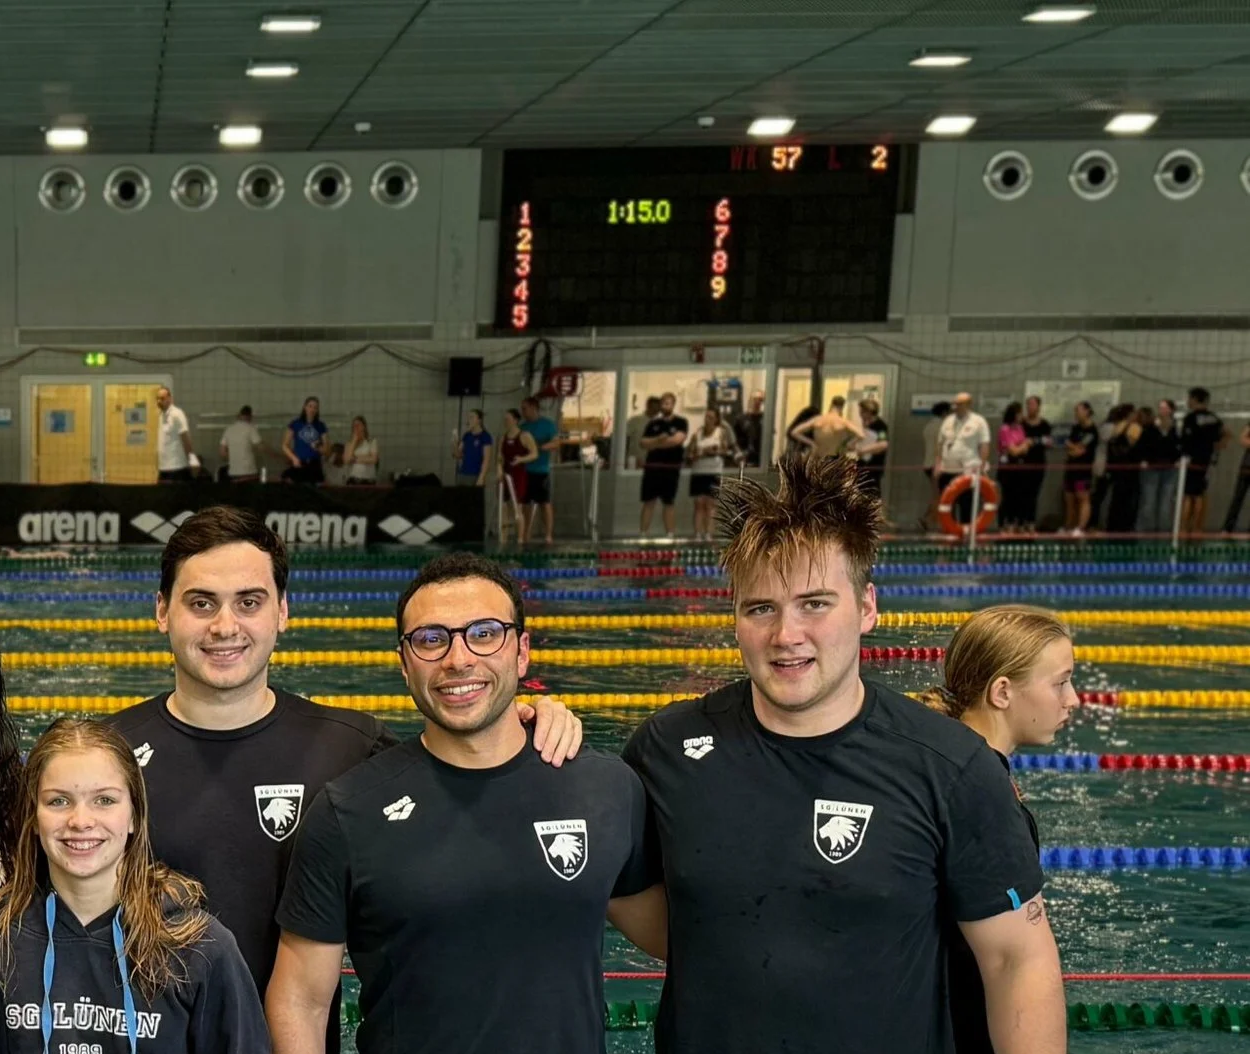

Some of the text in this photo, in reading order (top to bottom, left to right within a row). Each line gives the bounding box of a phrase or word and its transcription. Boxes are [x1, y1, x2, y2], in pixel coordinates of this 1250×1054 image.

[771, 145, 803, 170] 57
[828, 146, 842, 170] L
[870, 145, 888, 170] 2
[519, 199, 731, 225] 1 1:15.0 6
[516, 224, 729, 251] 2 7
[515, 250, 728, 277] 3 8
[514, 275, 726, 302] 4 9
[512, 304, 528, 328] 5
[19, 510, 120, 542] arena
[264, 511, 367, 545] arena
[683, 736, 713, 749] arena
[6, 996, 162, 1038] SG LÜNEN
